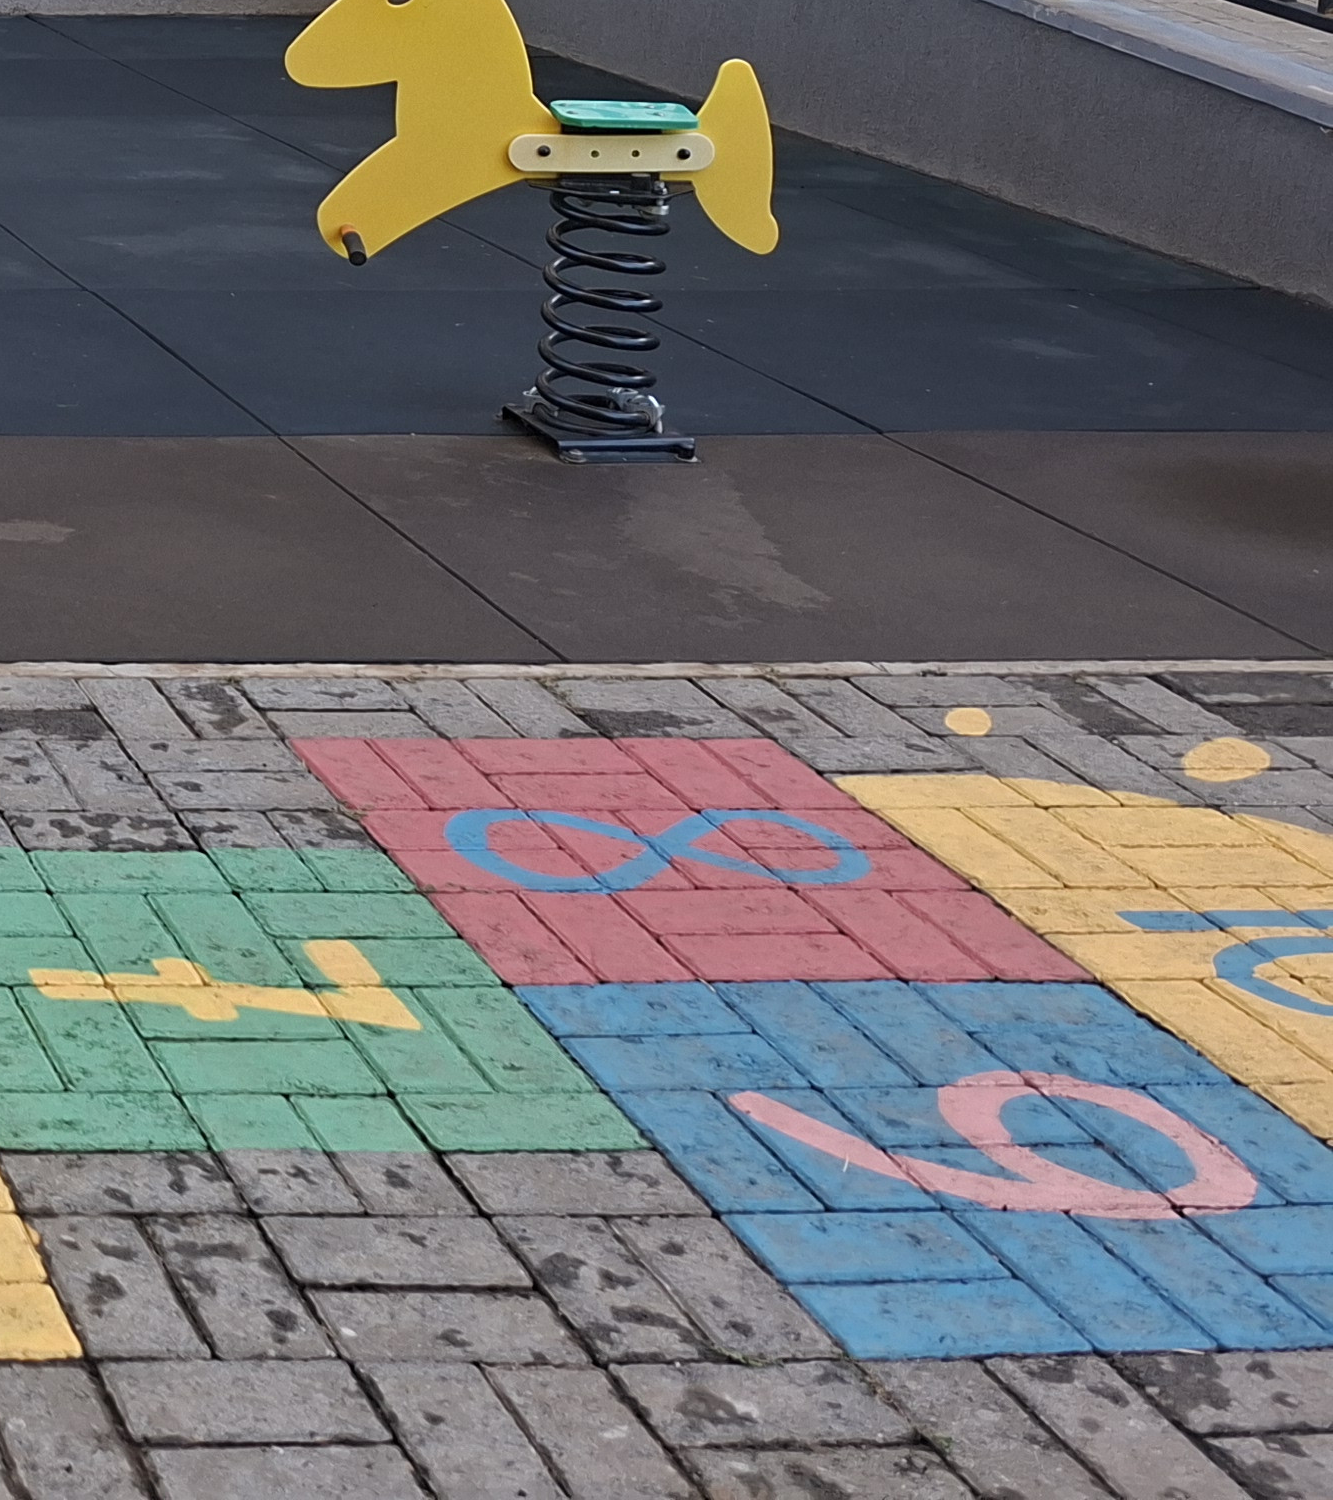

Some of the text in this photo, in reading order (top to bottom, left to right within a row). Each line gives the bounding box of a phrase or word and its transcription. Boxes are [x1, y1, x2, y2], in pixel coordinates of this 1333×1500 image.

[444, 809, 871, 893] 8
[28, 938, 423, 1031] 7
[727, 1069, 1259, 1220] 9
